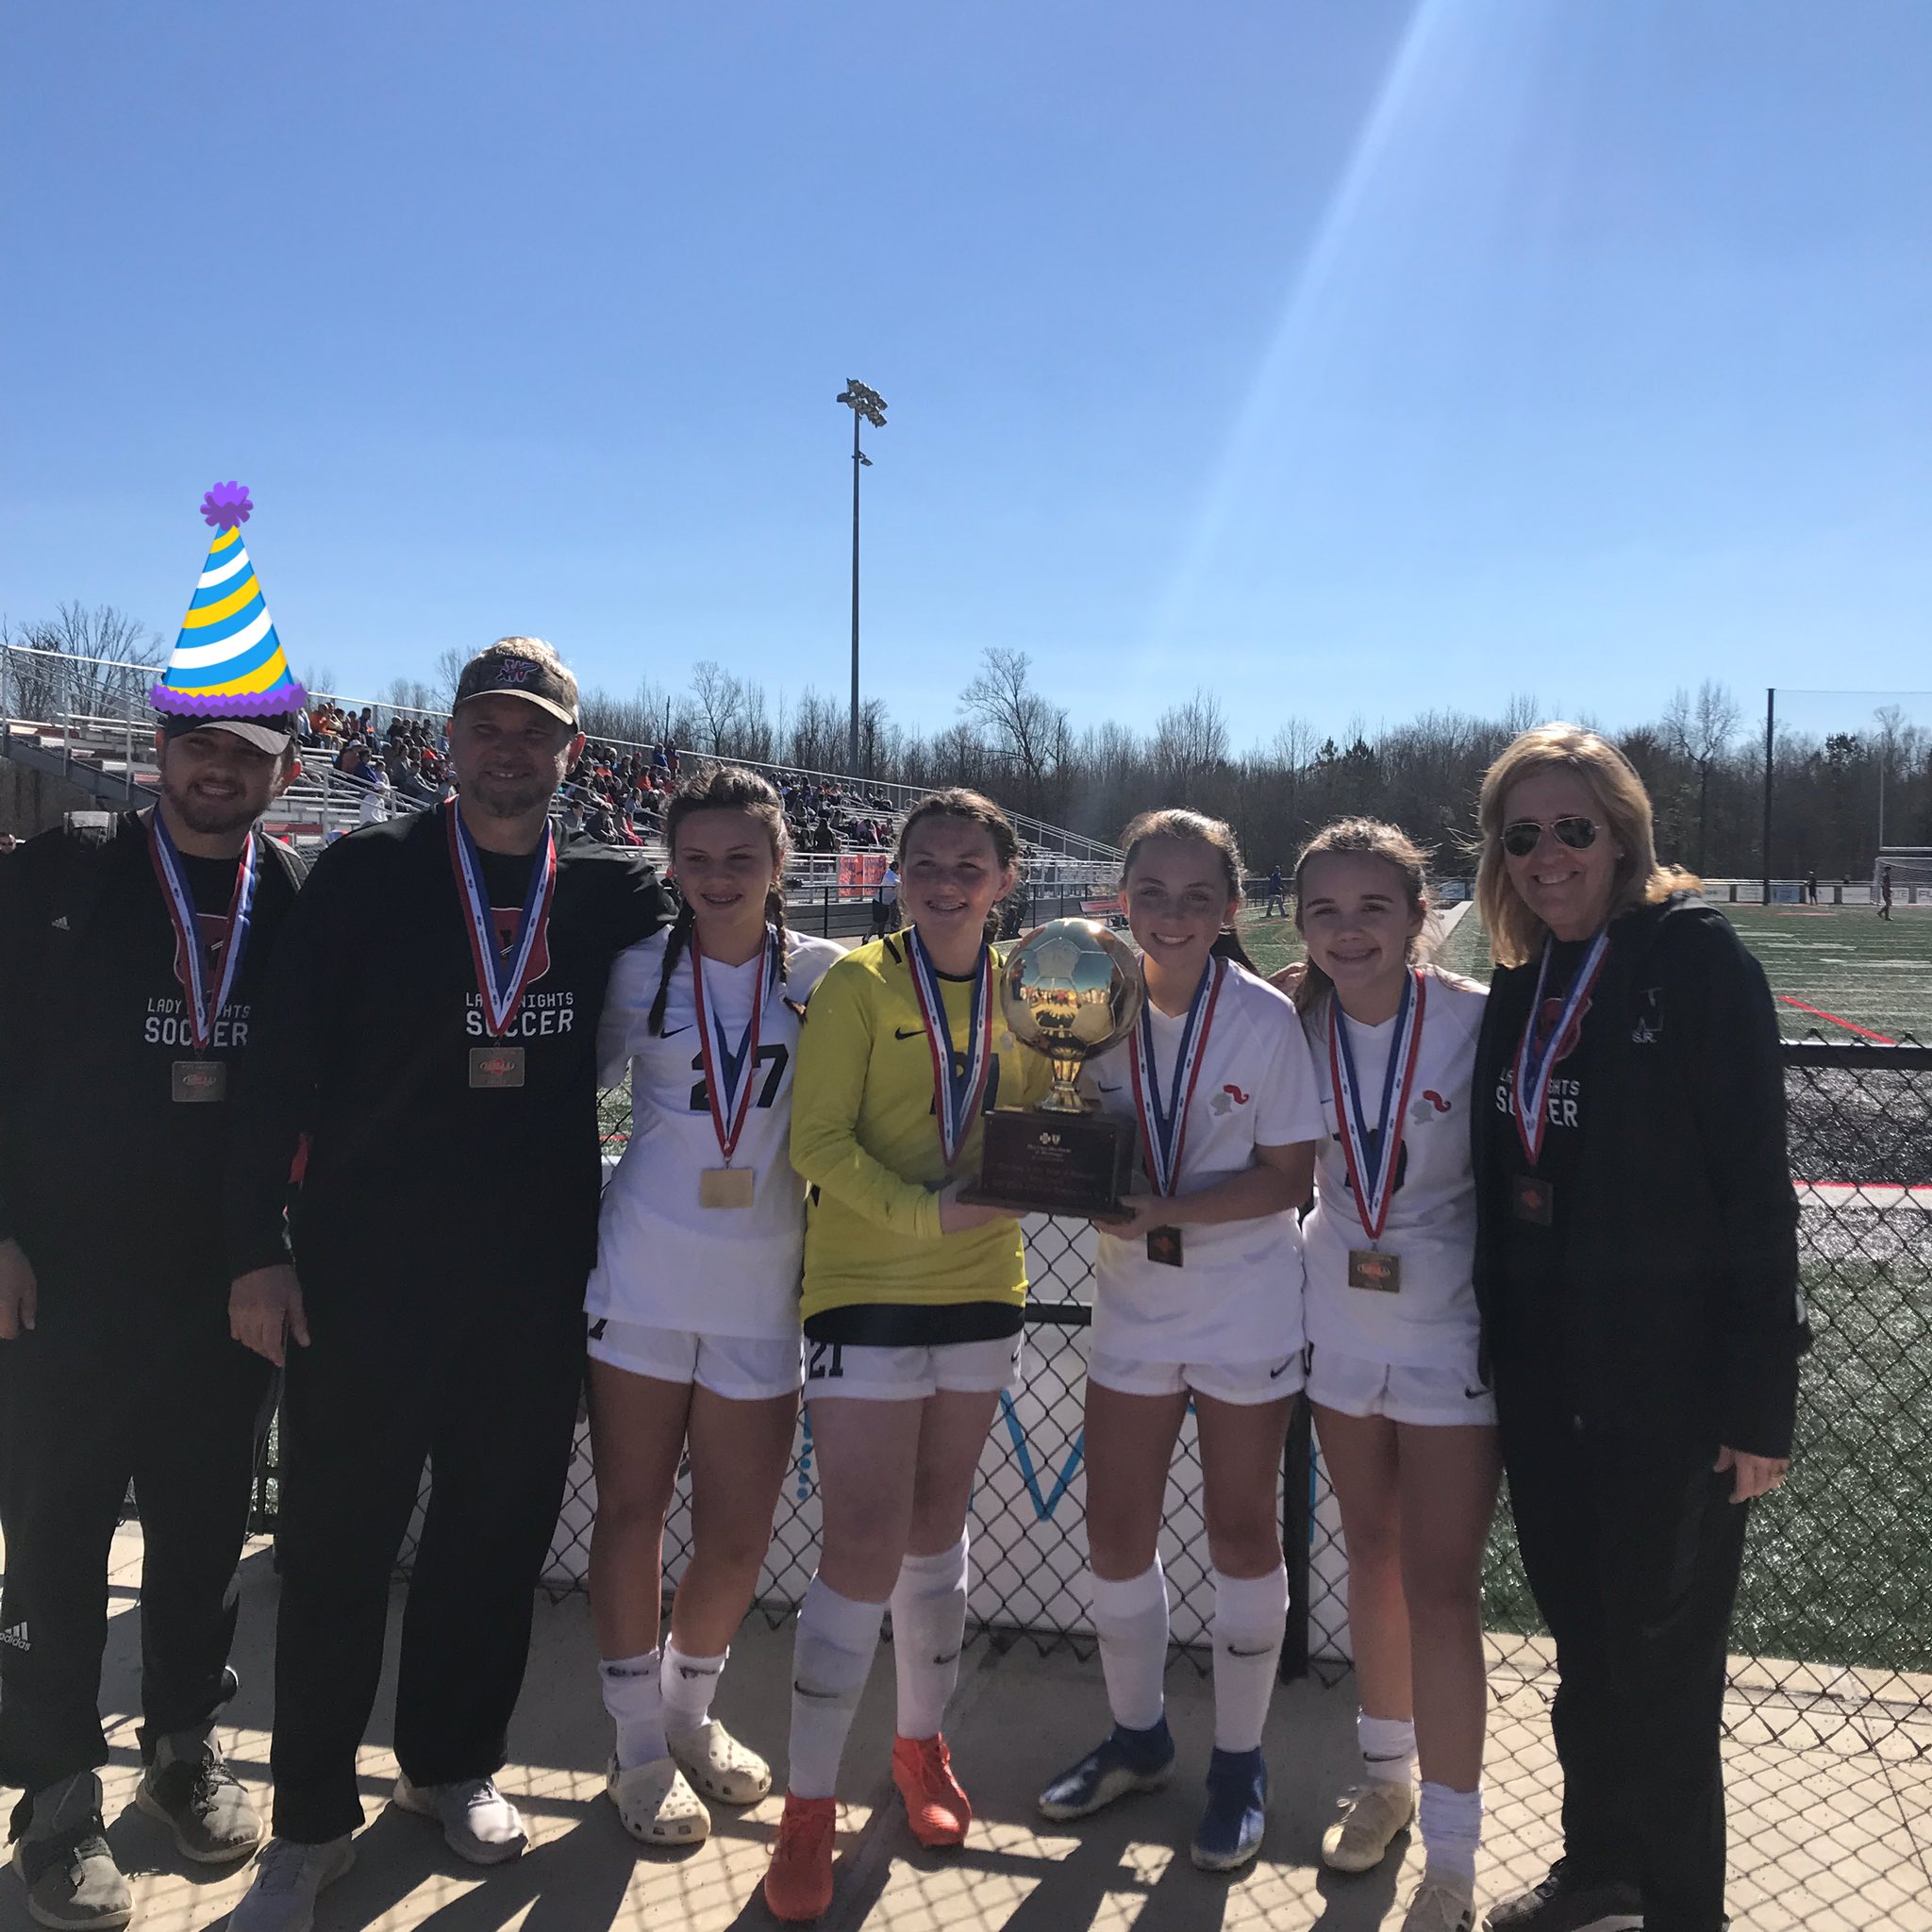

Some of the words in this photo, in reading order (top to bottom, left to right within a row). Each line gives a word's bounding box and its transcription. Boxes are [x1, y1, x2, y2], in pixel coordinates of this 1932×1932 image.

[147, 997, 182, 1014] LADY
[517, 991, 575, 1008] NIGHTS
[143, 1016, 249, 1047] SOCER
[1494, 1085, 1579, 1127] SER
[808, 1340, 843, 1380] 21
